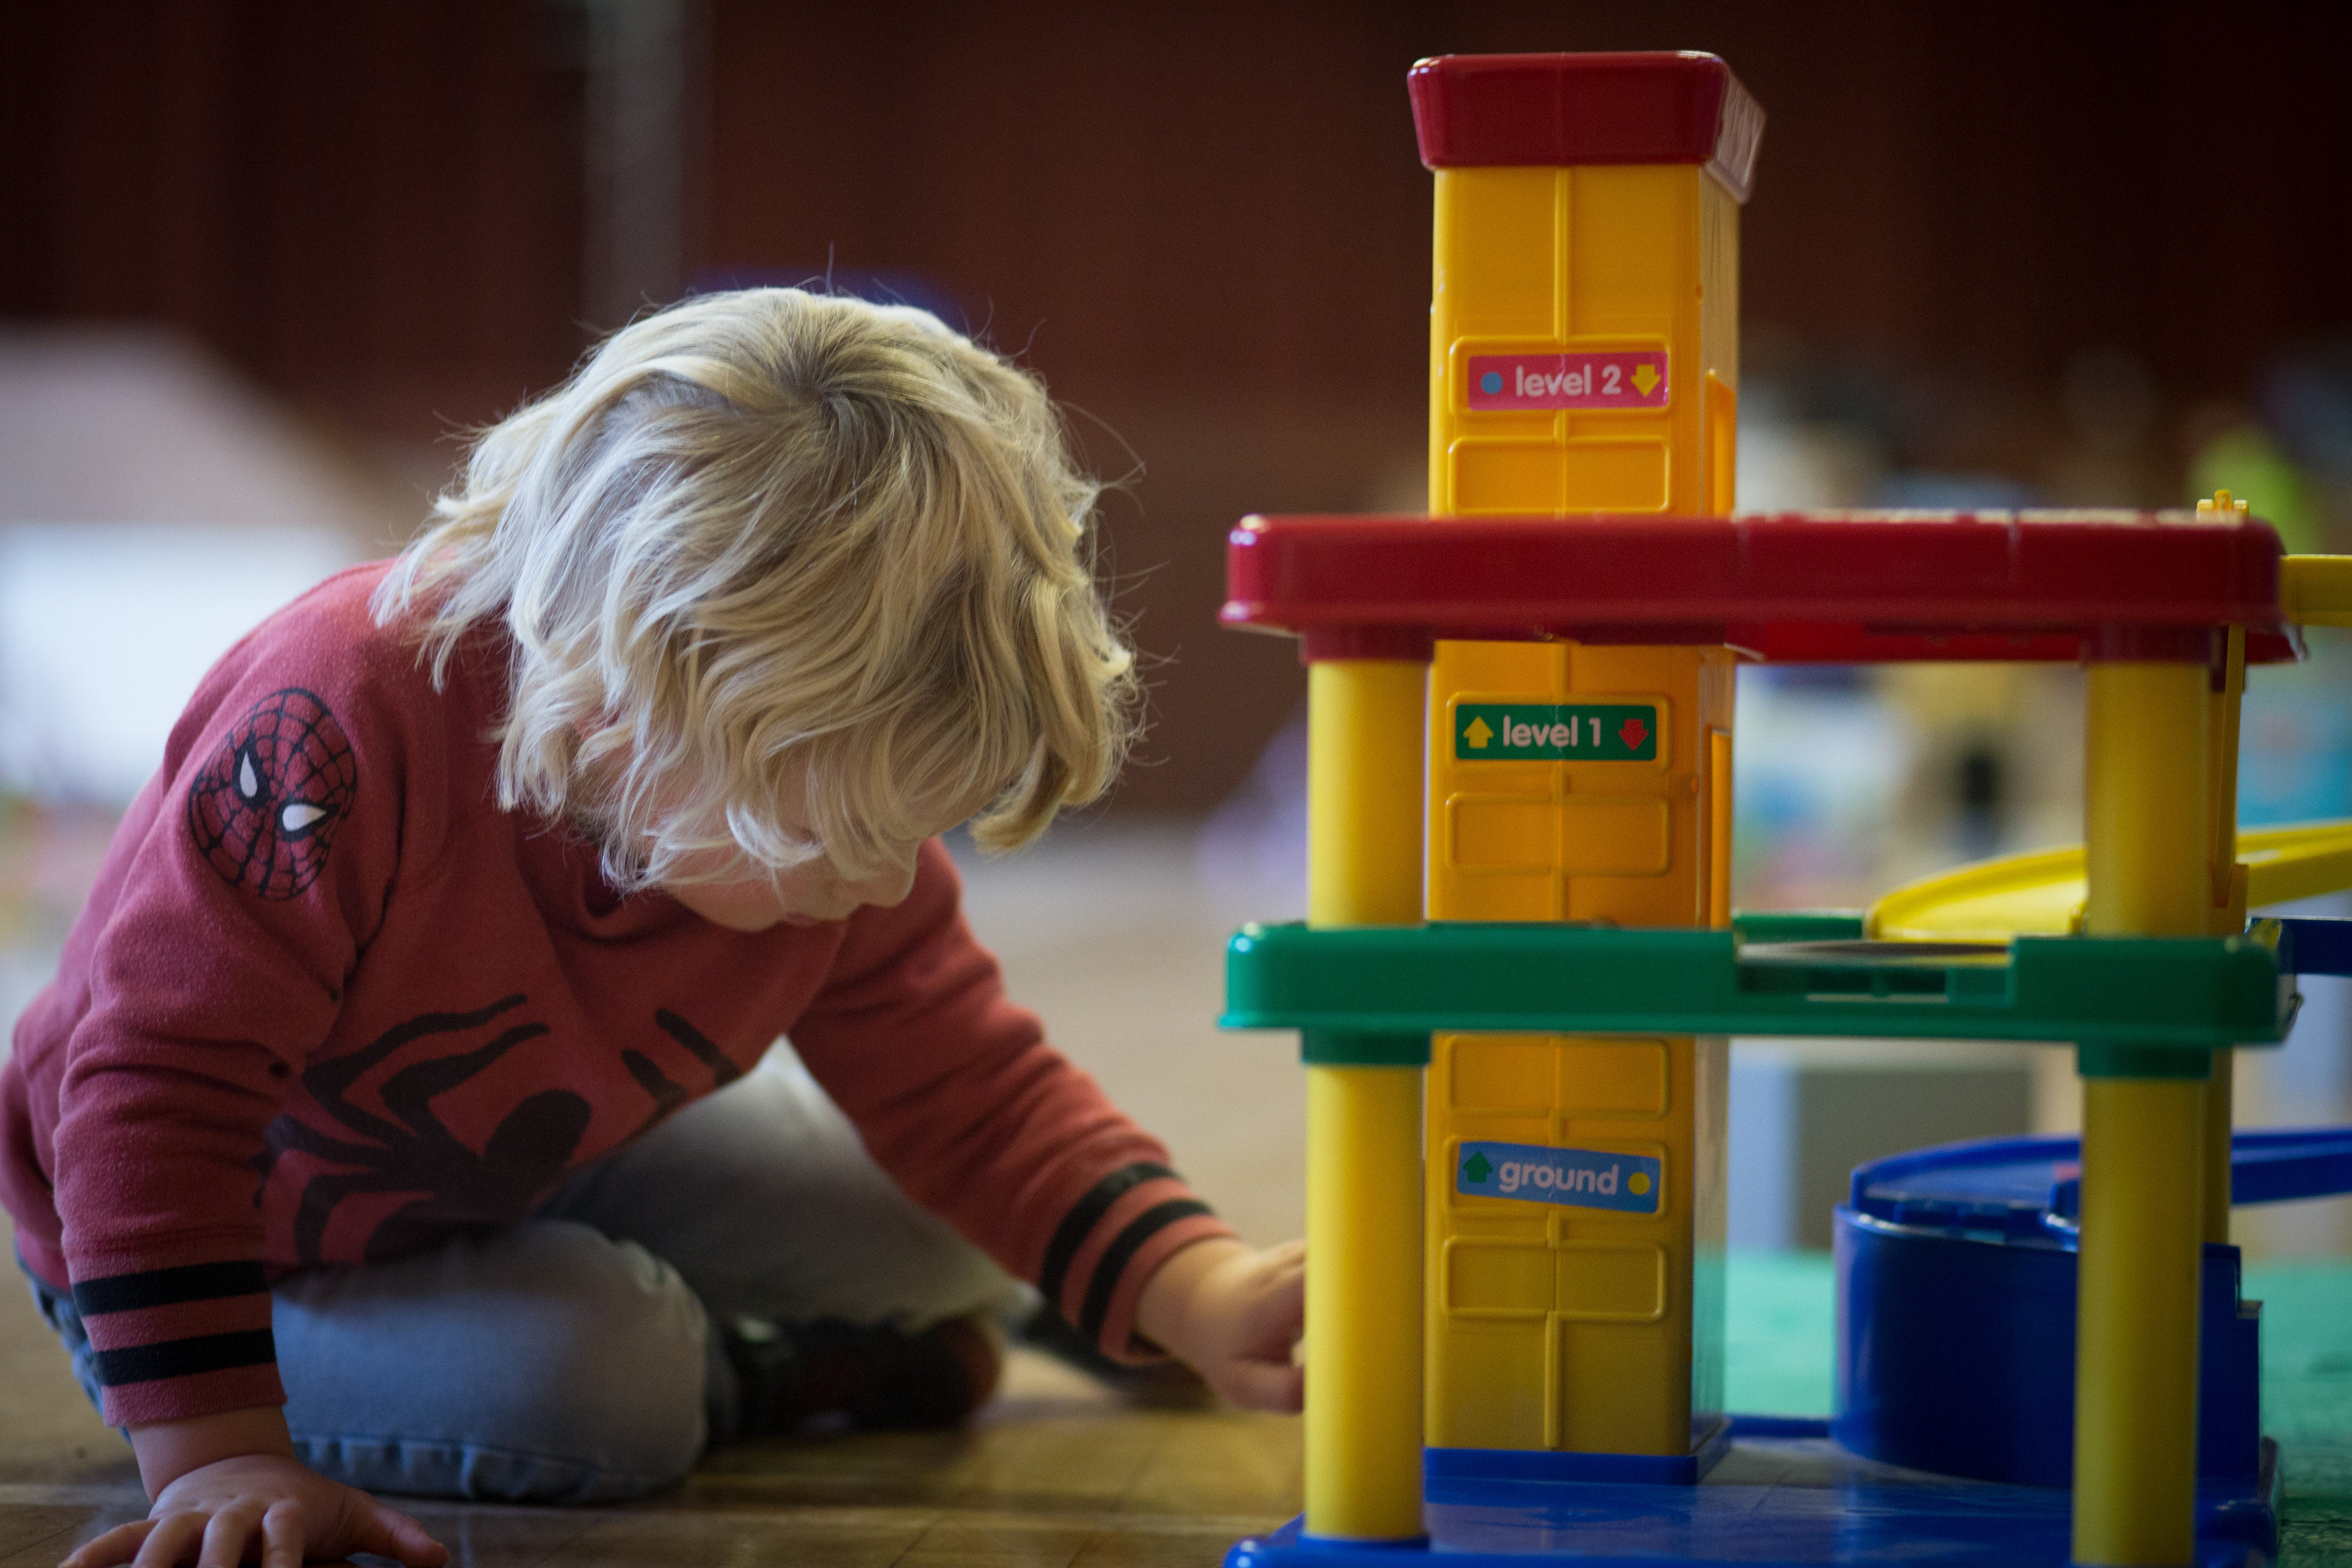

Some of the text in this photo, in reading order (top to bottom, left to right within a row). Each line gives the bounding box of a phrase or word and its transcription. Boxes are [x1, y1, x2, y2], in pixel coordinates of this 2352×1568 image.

[1515, 365, 1622, 396] level 2
[1503, 715, 1601, 747] level 1
[1498, 1161, 1619, 1195] ground
